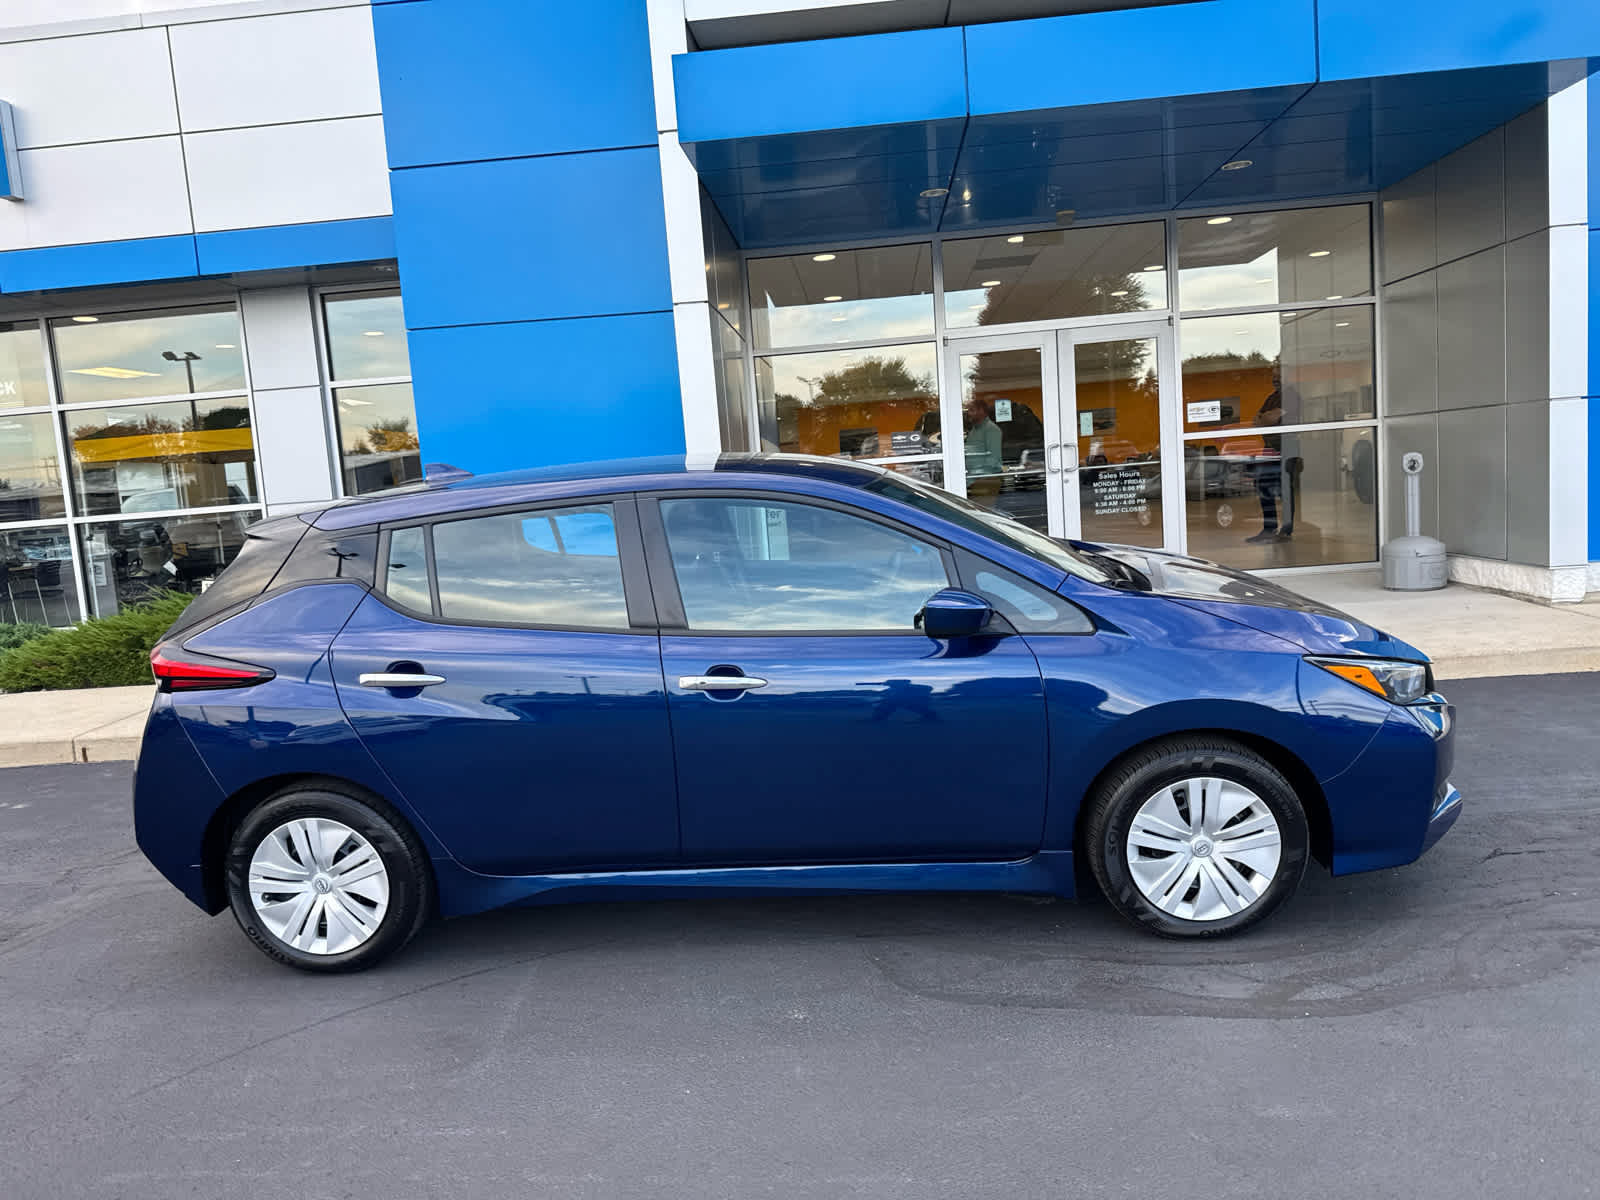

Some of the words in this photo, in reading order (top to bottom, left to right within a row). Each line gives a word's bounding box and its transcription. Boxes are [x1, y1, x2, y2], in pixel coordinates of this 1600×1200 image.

[1098, 472, 1118, 480] Sales
[1092, 480, 1119, 488] MONDAY
[1103, 493, 1136, 501] SATURDAY
